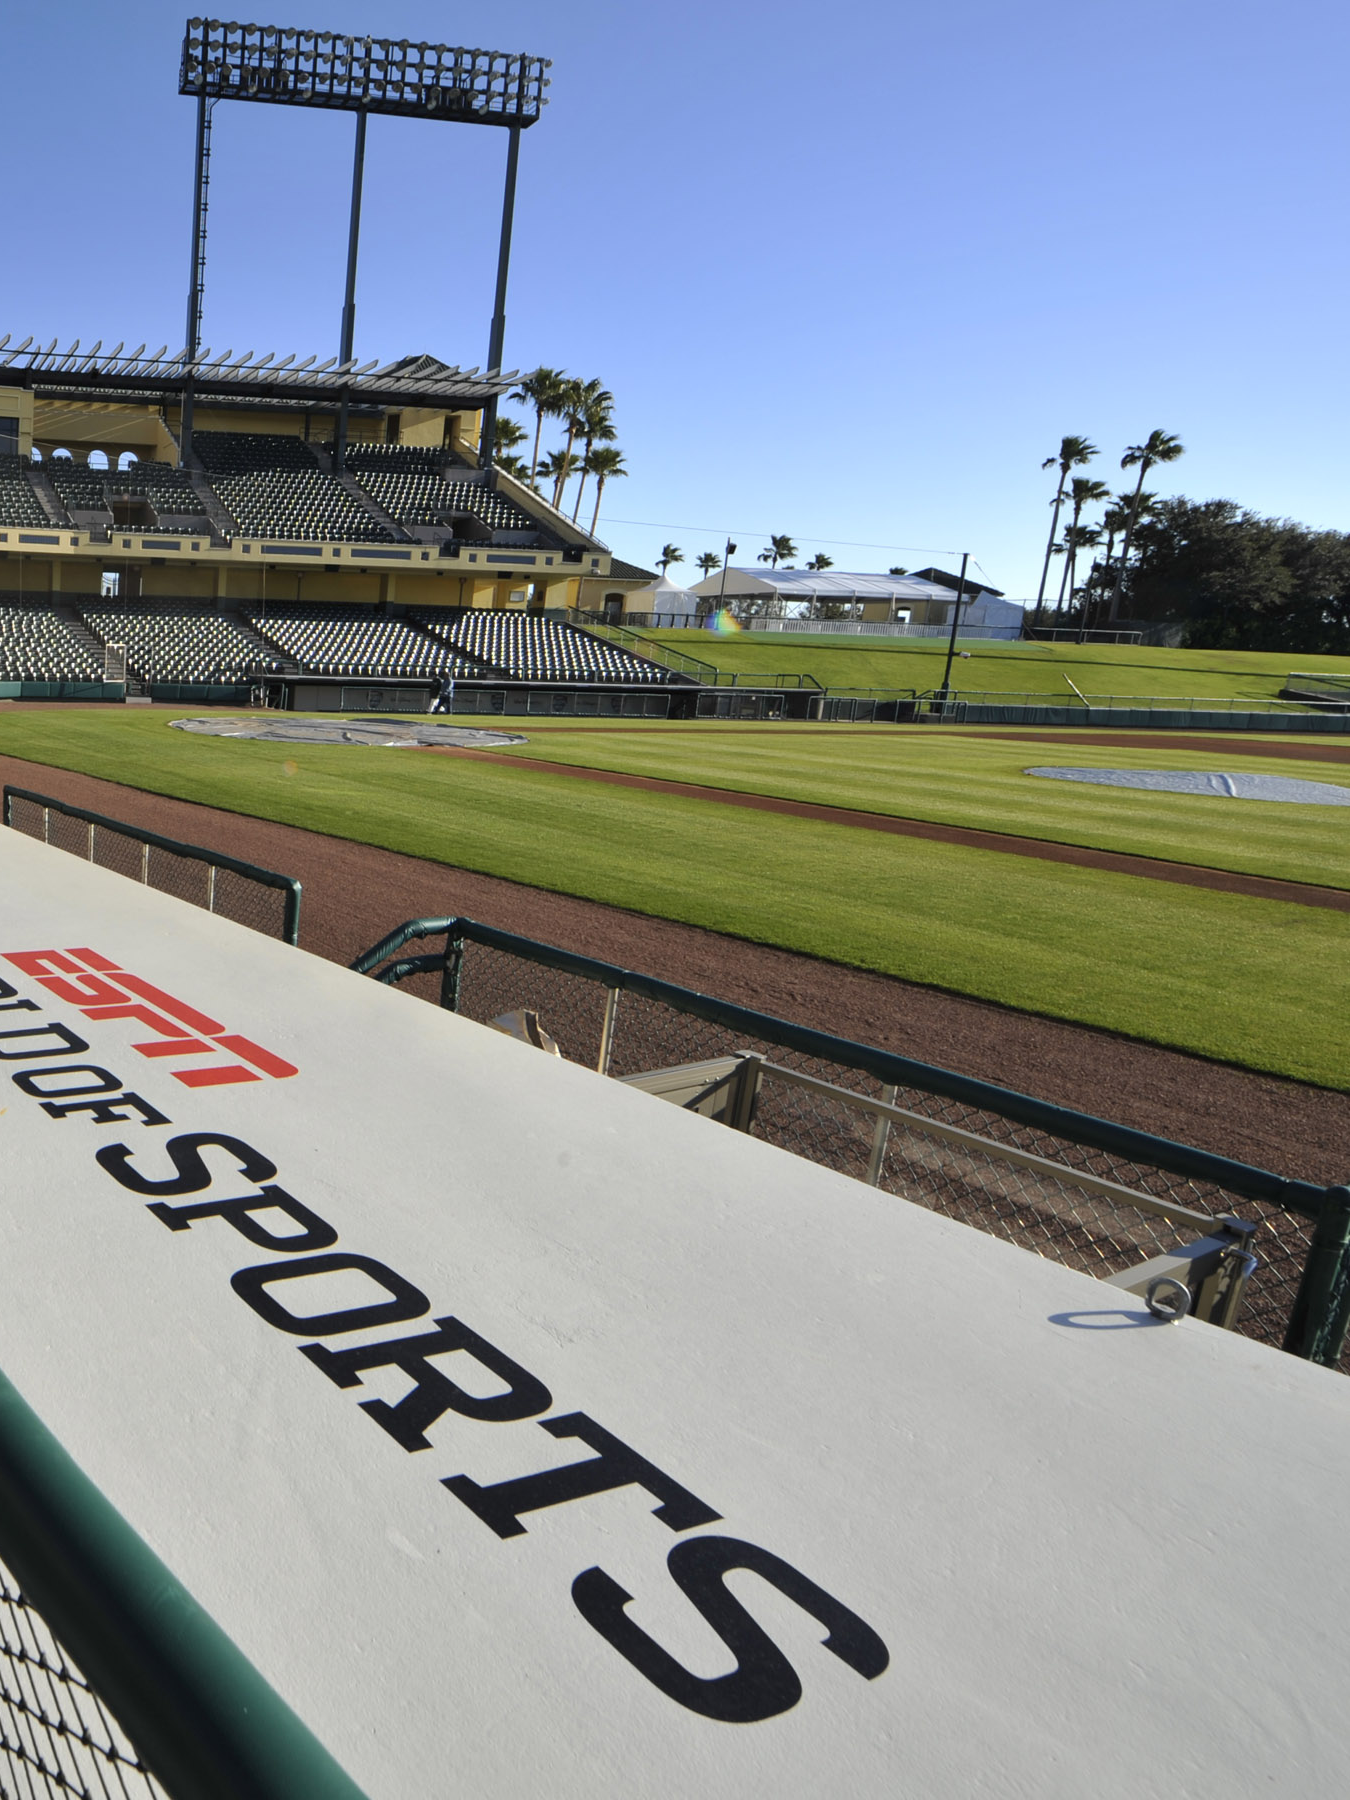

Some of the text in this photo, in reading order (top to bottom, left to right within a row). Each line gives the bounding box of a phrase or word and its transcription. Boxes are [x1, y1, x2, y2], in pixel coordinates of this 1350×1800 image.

[0, 947, 299, 1088] ESPN
[11, 1064, 173, 1127] OF
[95, 1132, 890, 1724] SPORTS
